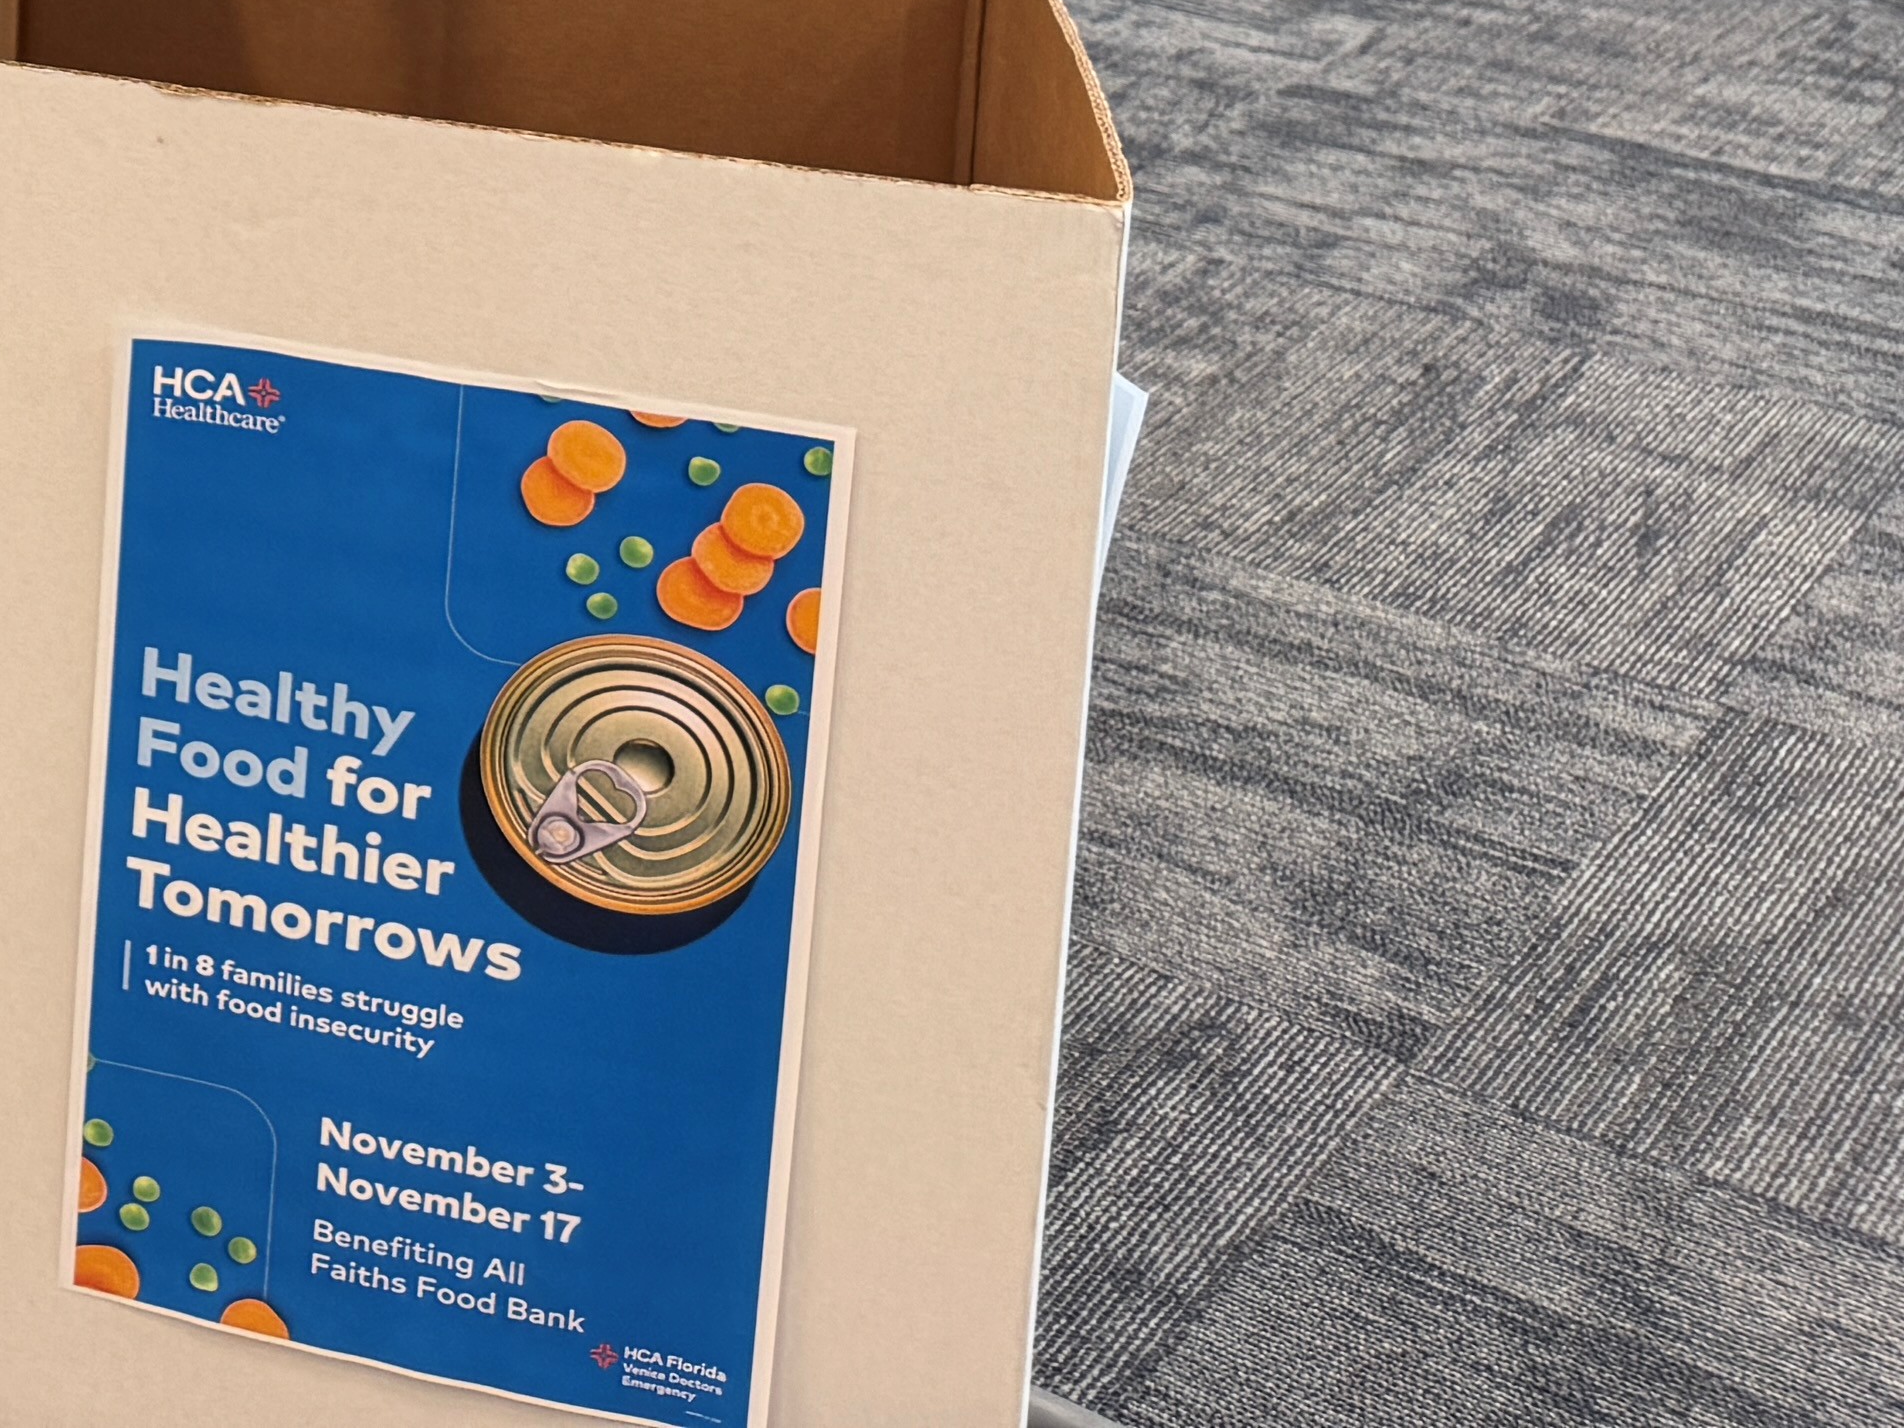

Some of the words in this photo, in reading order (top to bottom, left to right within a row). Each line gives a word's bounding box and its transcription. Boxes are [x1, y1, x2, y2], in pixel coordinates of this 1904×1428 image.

[153, 365, 246, 407] HCA
[142, 646, 416, 757] Healthy
[137, 716, 309, 799] Food
[325, 755, 433, 820] for
[131, 786, 456, 896] Healthier
[126, 855, 523, 982] Tomorrows
[144, 979, 209, 1007] with
[216, 989, 283, 1024] food
[290, 1005, 435, 1059] insecurity
[145, 944, 158, 966] 1
[164, 946, 189, 972] in
[195, 954, 215, 977] 8
[221, 959, 334, 1004] families
[340, 989, 464, 1031] struggle
[320, 1116, 535, 1187] November
[542, 1162, 585, 1195] 3-
[316, 1162, 532, 1233] November
[539, 1210, 582, 1244] 17
[313, 1218, 474, 1280] Benefiting
[483, 1257, 525, 1286] All
[311, 1252, 407, 1294] Faiths
[416, 1275, 497, 1315] Food
[507, 1296, 585, 1334] Bank
[621, 1374, 697, 1403] Emergency
[623, 1346, 664, 1366] HCA
[666, 1354, 727, 1383] Florida
[668, 1372, 723, 1396] Doctors
